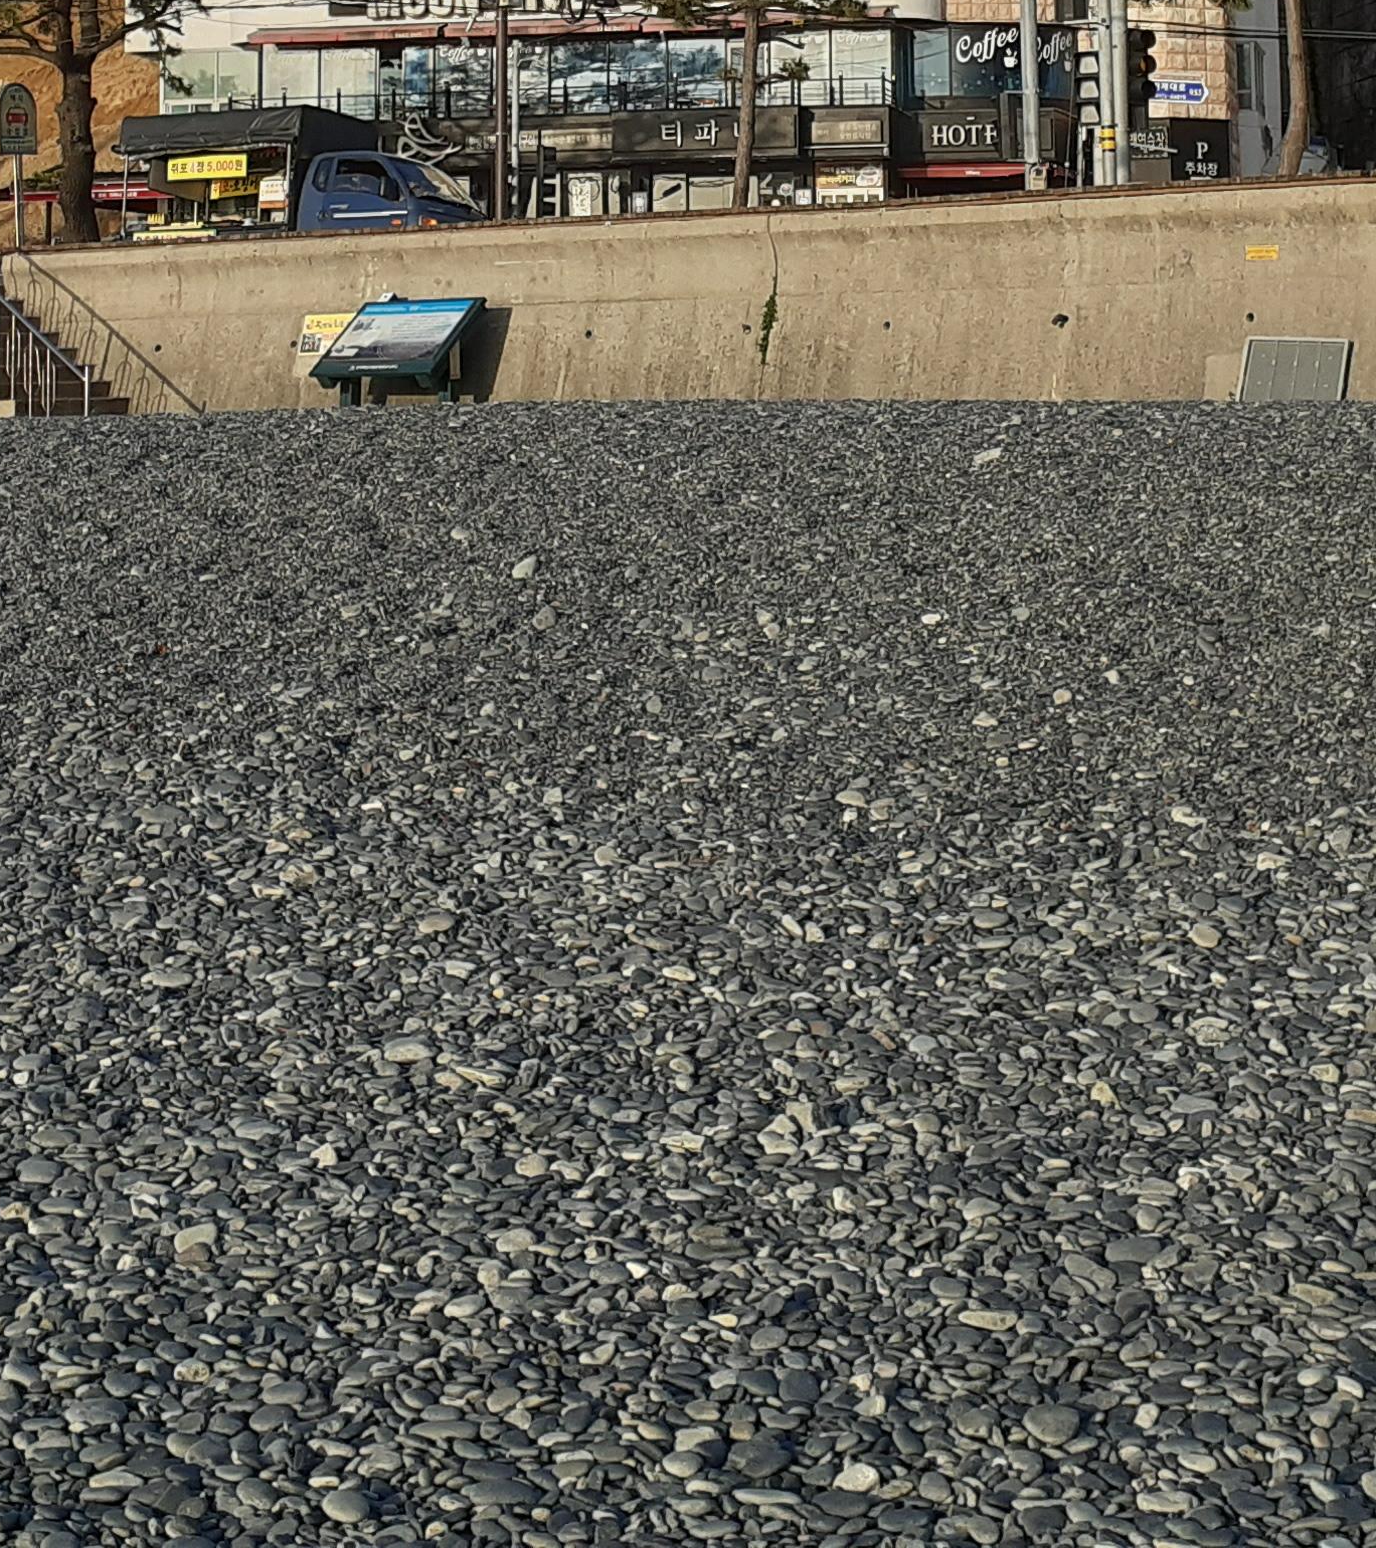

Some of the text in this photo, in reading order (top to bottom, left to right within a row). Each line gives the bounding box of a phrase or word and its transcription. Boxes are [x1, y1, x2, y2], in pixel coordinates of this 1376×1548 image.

[956, 28, 1019, 63] Coffee
[661, 119, 740, 148] 티파
[931, 123, 999, 146] HOTE
[1196, 142, 1208, 159] P
[1185, 162, 1218, 176] 주차장
